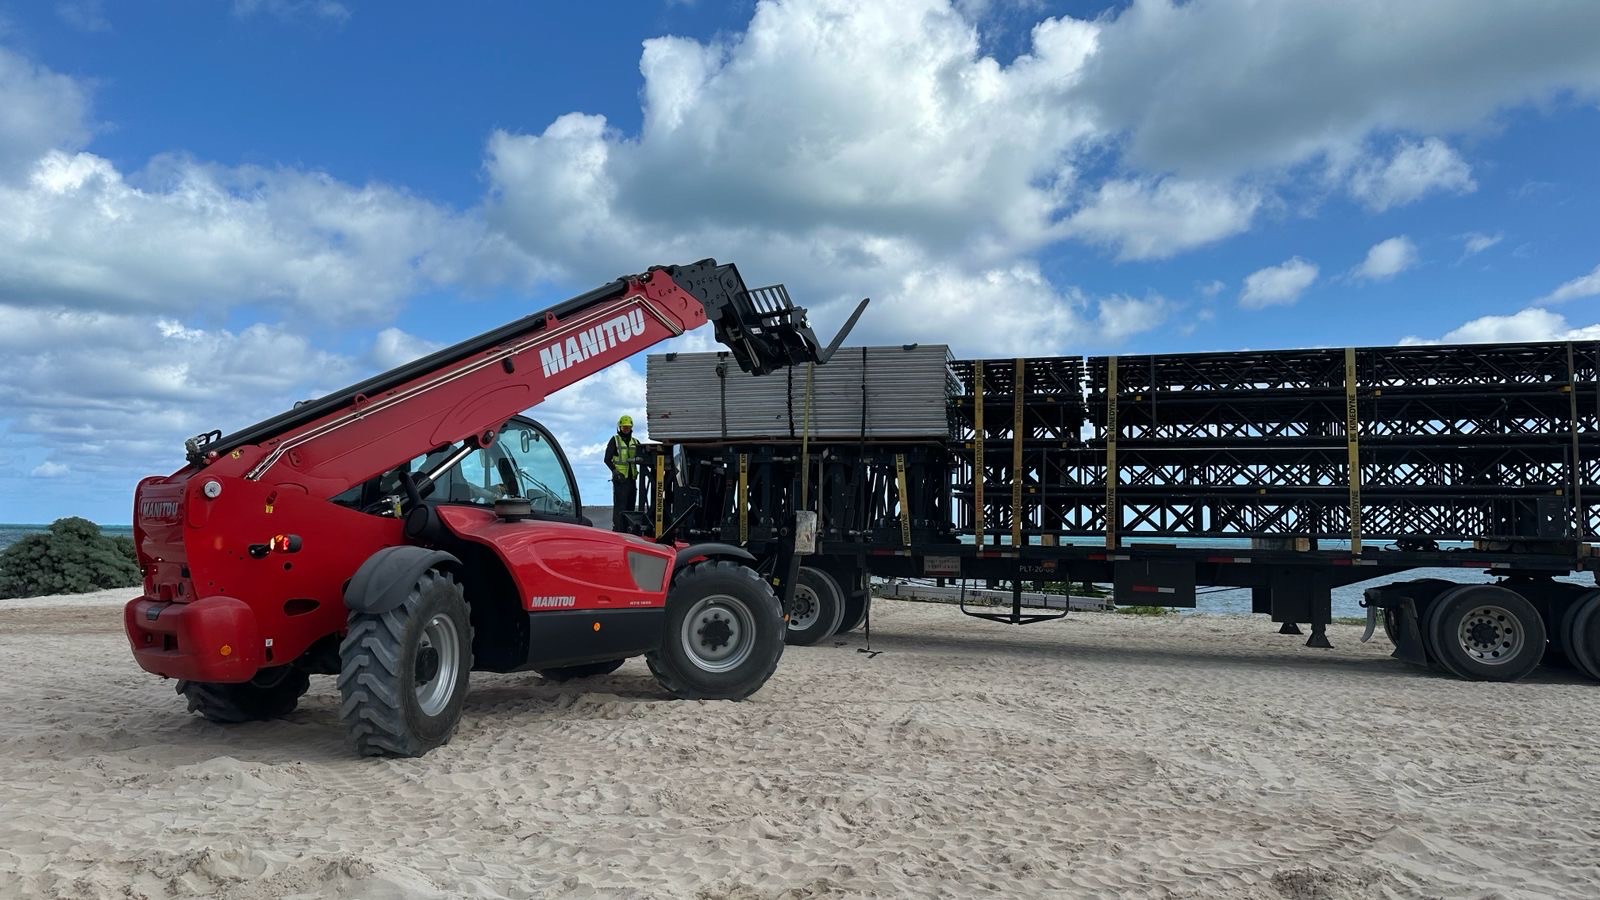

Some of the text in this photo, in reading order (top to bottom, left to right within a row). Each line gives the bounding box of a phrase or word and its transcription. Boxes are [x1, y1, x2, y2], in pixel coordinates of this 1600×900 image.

[540, 308, 645, 378] MANITOU
[143, 502, 179, 517] MANITOU
[532, 596, 576, 608] MANITOU
